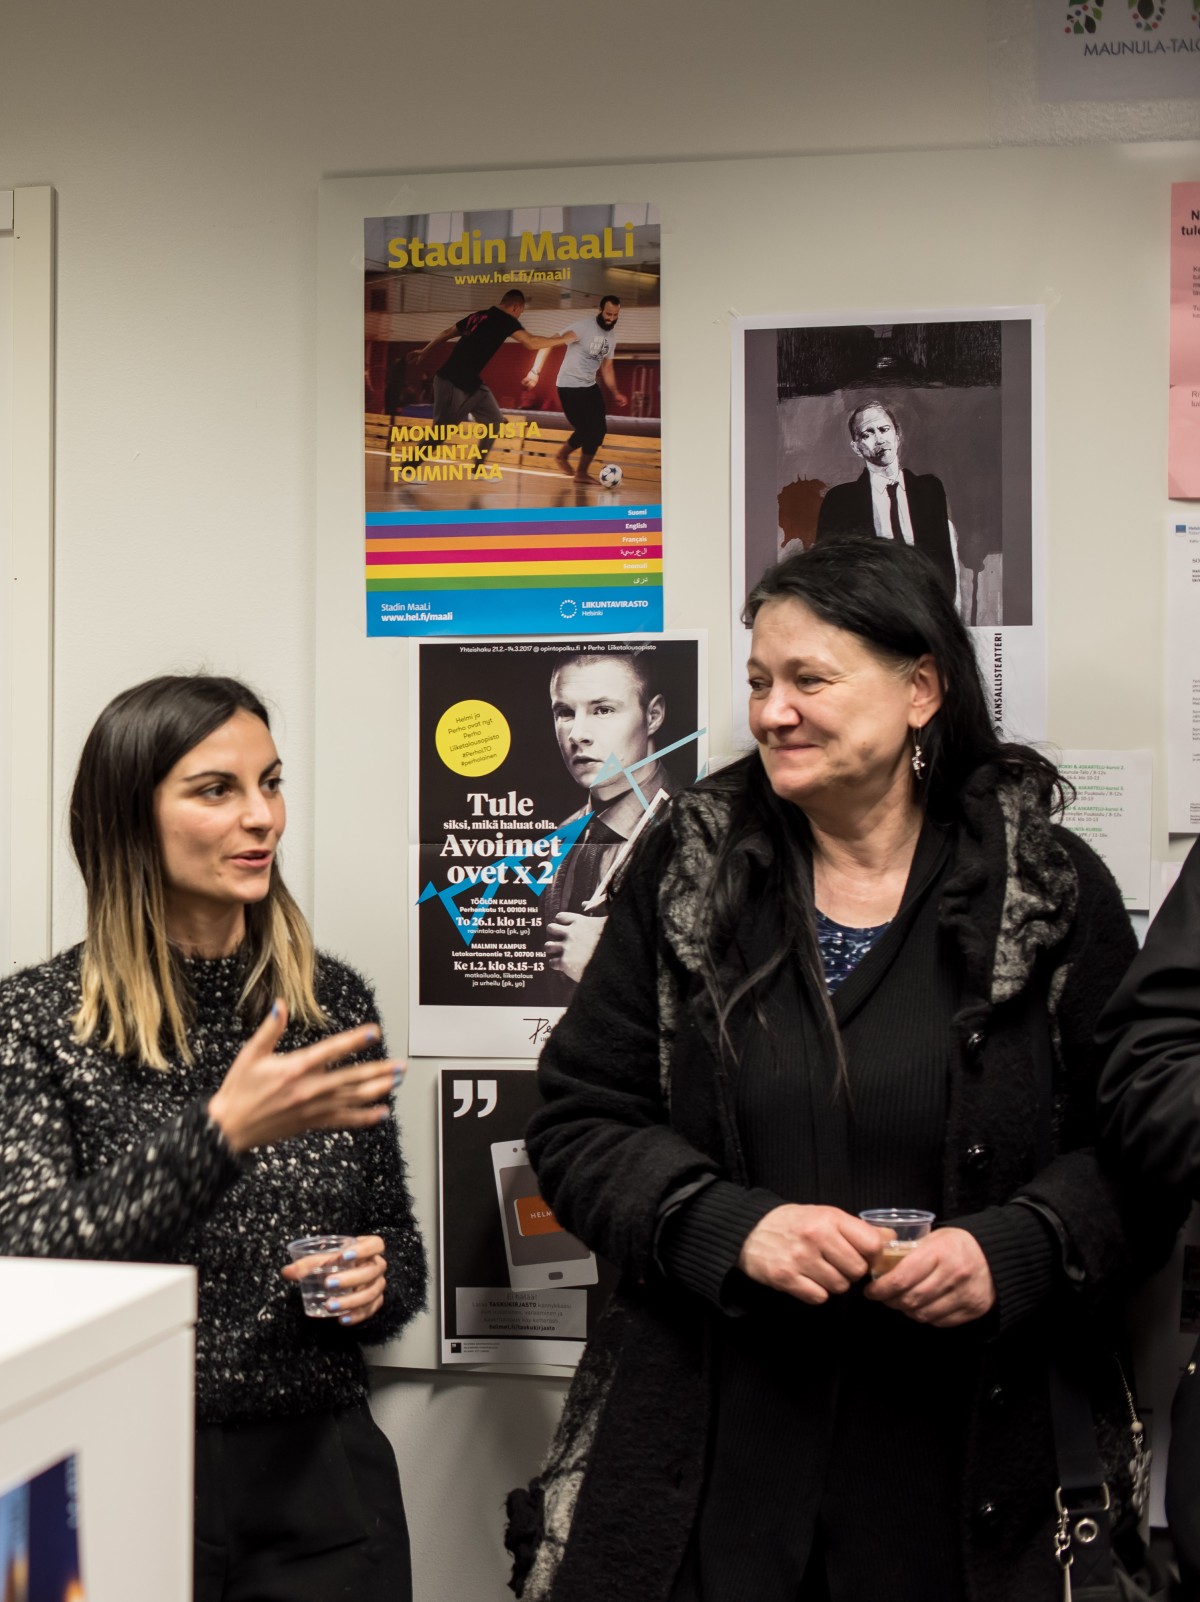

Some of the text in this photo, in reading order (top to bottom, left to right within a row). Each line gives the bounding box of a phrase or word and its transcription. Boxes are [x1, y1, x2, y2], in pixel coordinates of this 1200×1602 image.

[388, 222, 635, 269] Stadin MaaLi
[455, 268, 571, 285] www.hel.fi/maali
[390, 421, 542, 443] MONIPUOLISTA
[391, 444, 488, 463] LIIKUNTA-
[390, 463, 503, 483] TOIMINTAA
[625, 522, 648, 531] English
[622, 536, 648, 544] Français
[381, 602, 431, 612] Stadin MaaLi
[581, 600, 649, 609] LIIKUNTAVIRASTO
[381, 611, 453, 623] www.hel.fi/maali
[540, 645, 581, 653] opintopolku.fi
[607, 644, 657, 652] Liiketalousopisto
[994, 632, 1003, 722] KANSALLISTEATTERI
[455, 714, 474, 723] Helmi
[448, 718, 493, 734] Perho ovat nyt
[463, 730, 482, 739] Perho
[450, 734, 500, 752] Liiketalousopisto
[467, 791, 534, 817] Tule
[443, 820, 558, 831] siksi, mikä haluat olla.
[440, 832, 562, 857] Avoimet
[447, 861, 554, 885] ovet x 2
[471, 897, 498, 905] TÖÖLÖN
[456, 917, 470, 926] To
[471, 917, 496, 927] 26.1.
[496, 917, 515, 927] klo
[453, 961, 469, 971] Ke
[469, 961, 487, 971] 1.2.
[488, 961, 506, 971] klo
[472, 980, 479, 988] ja
